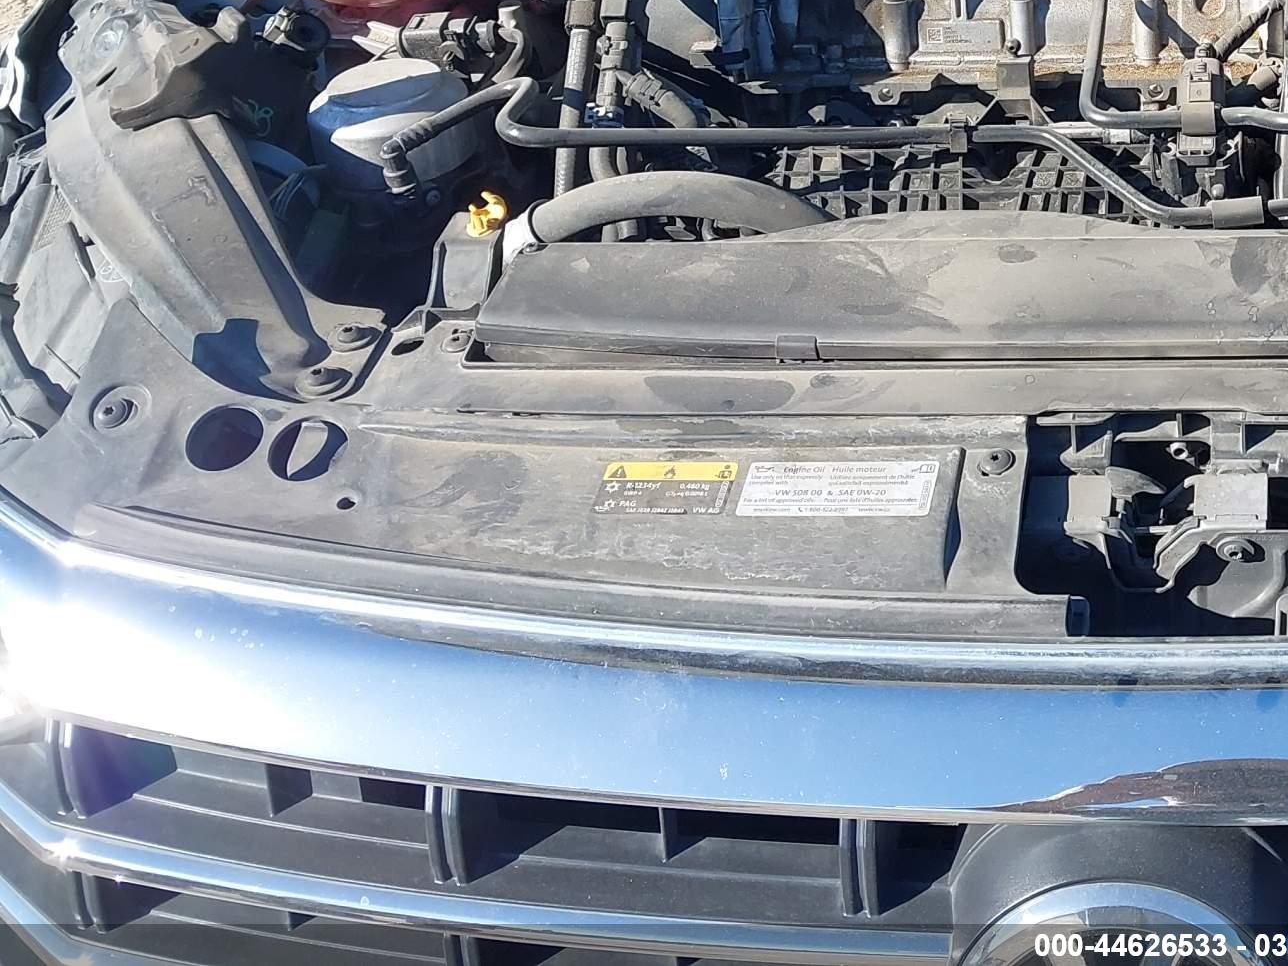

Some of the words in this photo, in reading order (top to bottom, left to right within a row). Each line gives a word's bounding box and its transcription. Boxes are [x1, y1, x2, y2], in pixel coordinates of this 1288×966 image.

[784, 466, 812, 474] Engine
[832, 466, 854, 474] Huile
[626, 482, 661, 491] R-1234yf
